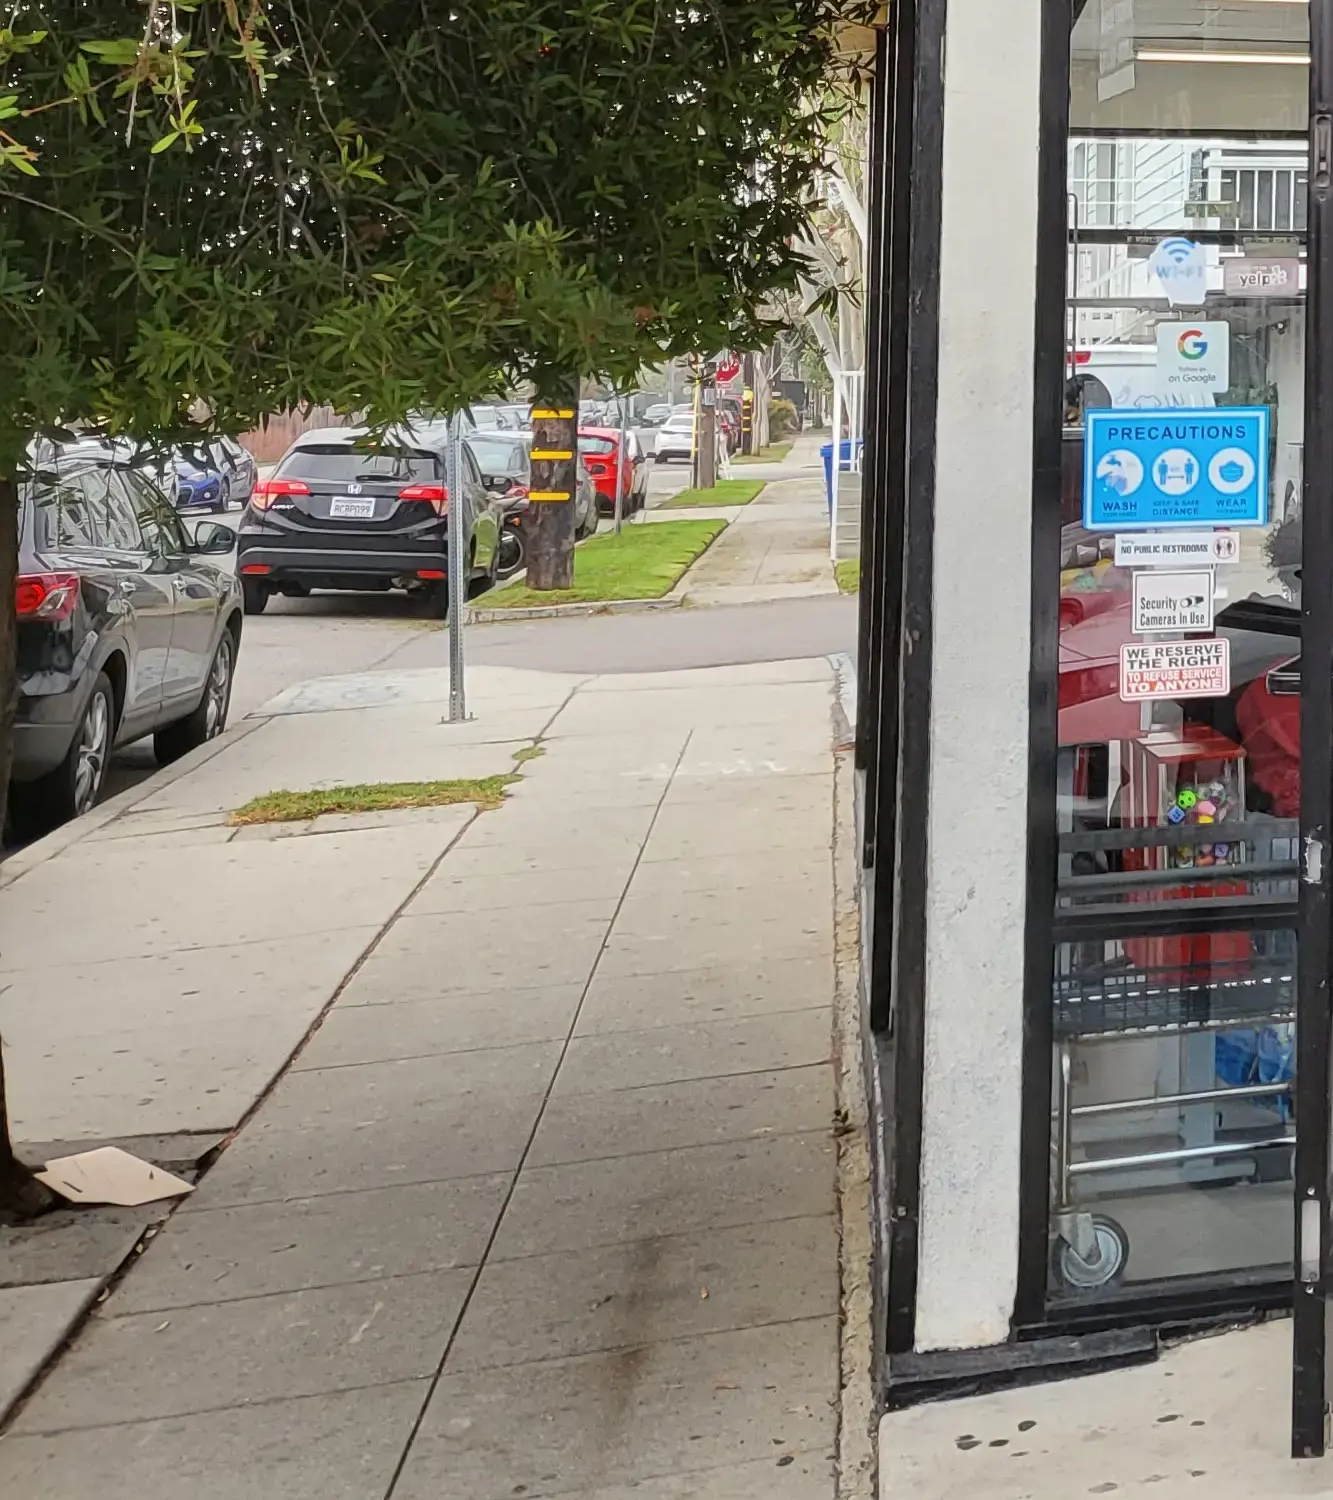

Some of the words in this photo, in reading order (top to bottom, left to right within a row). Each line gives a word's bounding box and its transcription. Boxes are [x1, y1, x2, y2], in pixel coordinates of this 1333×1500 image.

[1239, 271, 1270, 287] yelp
[1168, 374, 1180, 383] on
[1182, 373, 1216, 385] Google
[1108, 425, 1246, 441] PRECAUTIONS
[1102, 501, 1137, 511] WASH
[1216, 499, 1247, 507] WEAR
[1152, 507, 1199, 516] DISTANCE
[1121, 545, 1132, 554] NO
[1134, 544, 1161, 554] PUBLIC
[1162, 543, 1208, 554] RESTROOMS
[1140, 596, 1177, 611] Security
[1140, 613, 1176, 627] Cameras
[1180, 612, 1187, 624] In
[1190, 612, 1205, 624] Use
[1127, 648, 1149, 659] WE
[1155, 644, 1223, 658] RESERVE
[1127, 658, 1162, 670] THE
[1168, 655, 1223, 668] RIGHT
[1127, 672, 1141, 683] TO
[1143, 670, 1181, 682] REFUSE
[1182, 667, 1222, 679] SERVICE
[1128, 681, 1150, 694] TO
[1153, 678, 1222, 692] ANYONE
